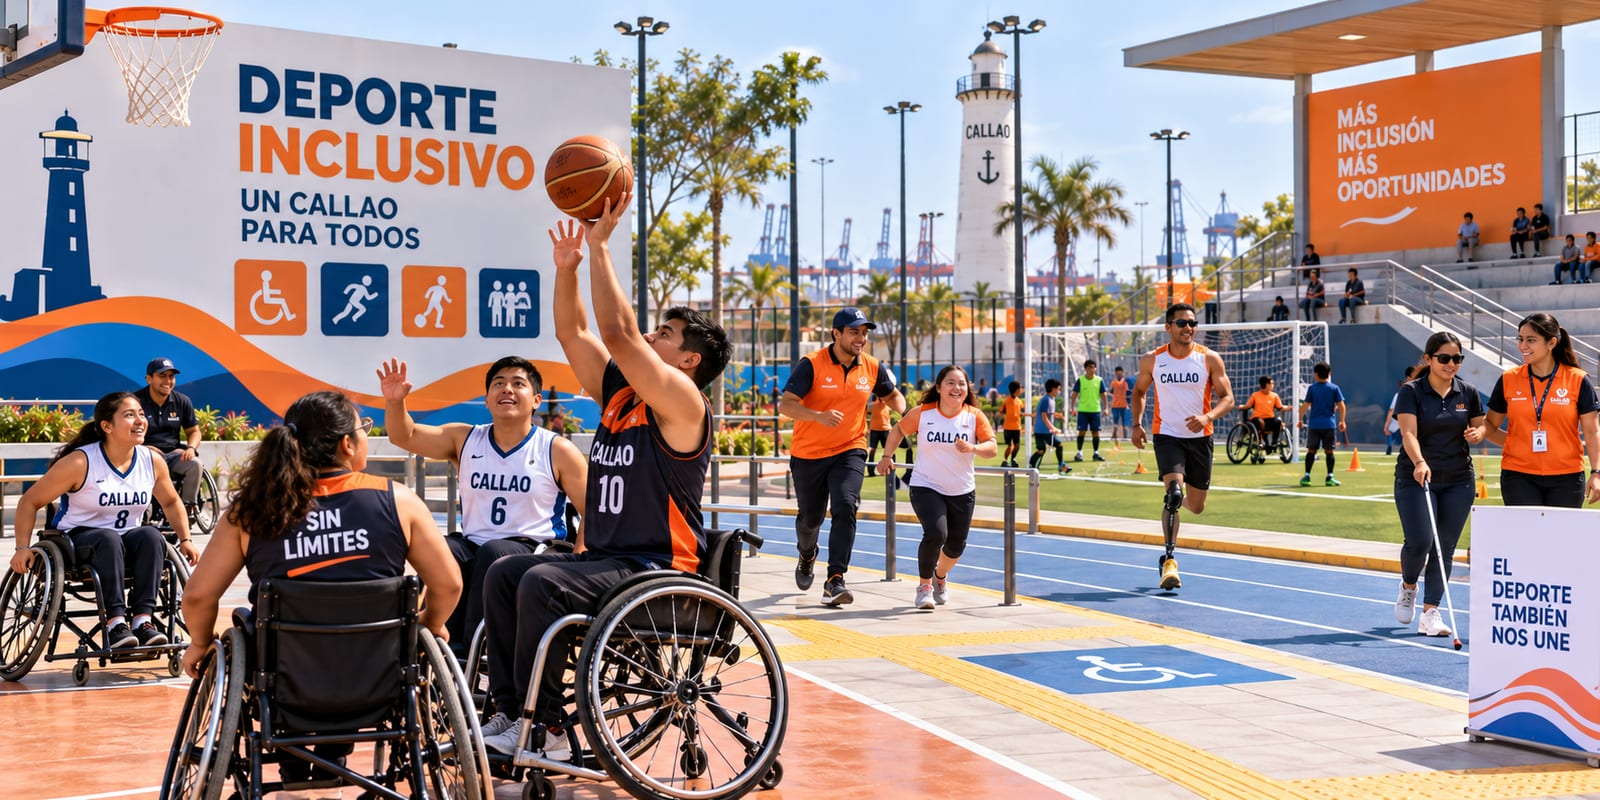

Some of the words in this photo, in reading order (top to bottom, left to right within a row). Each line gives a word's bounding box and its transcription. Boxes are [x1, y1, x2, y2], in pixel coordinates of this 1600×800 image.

[238, 63, 497, 136] DEPORTE
[1337, 100, 1378, 129] MÁS
[966, 123, 1011, 139] CALLAO
[1337, 116, 1435, 154] INCLUSIÓN
[239, 122, 535, 191] INCLUSIVO
[1337, 152, 1378, 178] MÁS
[1337, 162, 1506, 202] OPORTUNIDADES
[241, 188, 281, 214] UN
[289, 191, 398, 220] CALLAO
[241, 218, 318, 246] PARA
[324, 222, 421, 250] TODOS
[1160, 372, 1200, 384] CALLAO
[926, 431, 969, 443] CALLAO
[590, 440, 635, 467] CALLAO
[470, 471, 532, 493] CALLAO
[598, 474, 625, 515] 10
[98, 491, 148, 507] CALLAO
[490, 496, 508, 526] 6
[114, 509, 130, 530] 8
[305, 508, 342, 532] SIN
[283, 528, 370, 560] LÍMITES
[1492, 557, 1513, 577] EL
[1492, 580, 1572, 605] DEPORTE
[1491, 602, 1568, 628] TAMBIÉN
[1491, 625, 1529, 647] NOS
[1533, 630, 1571, 652] UNE
